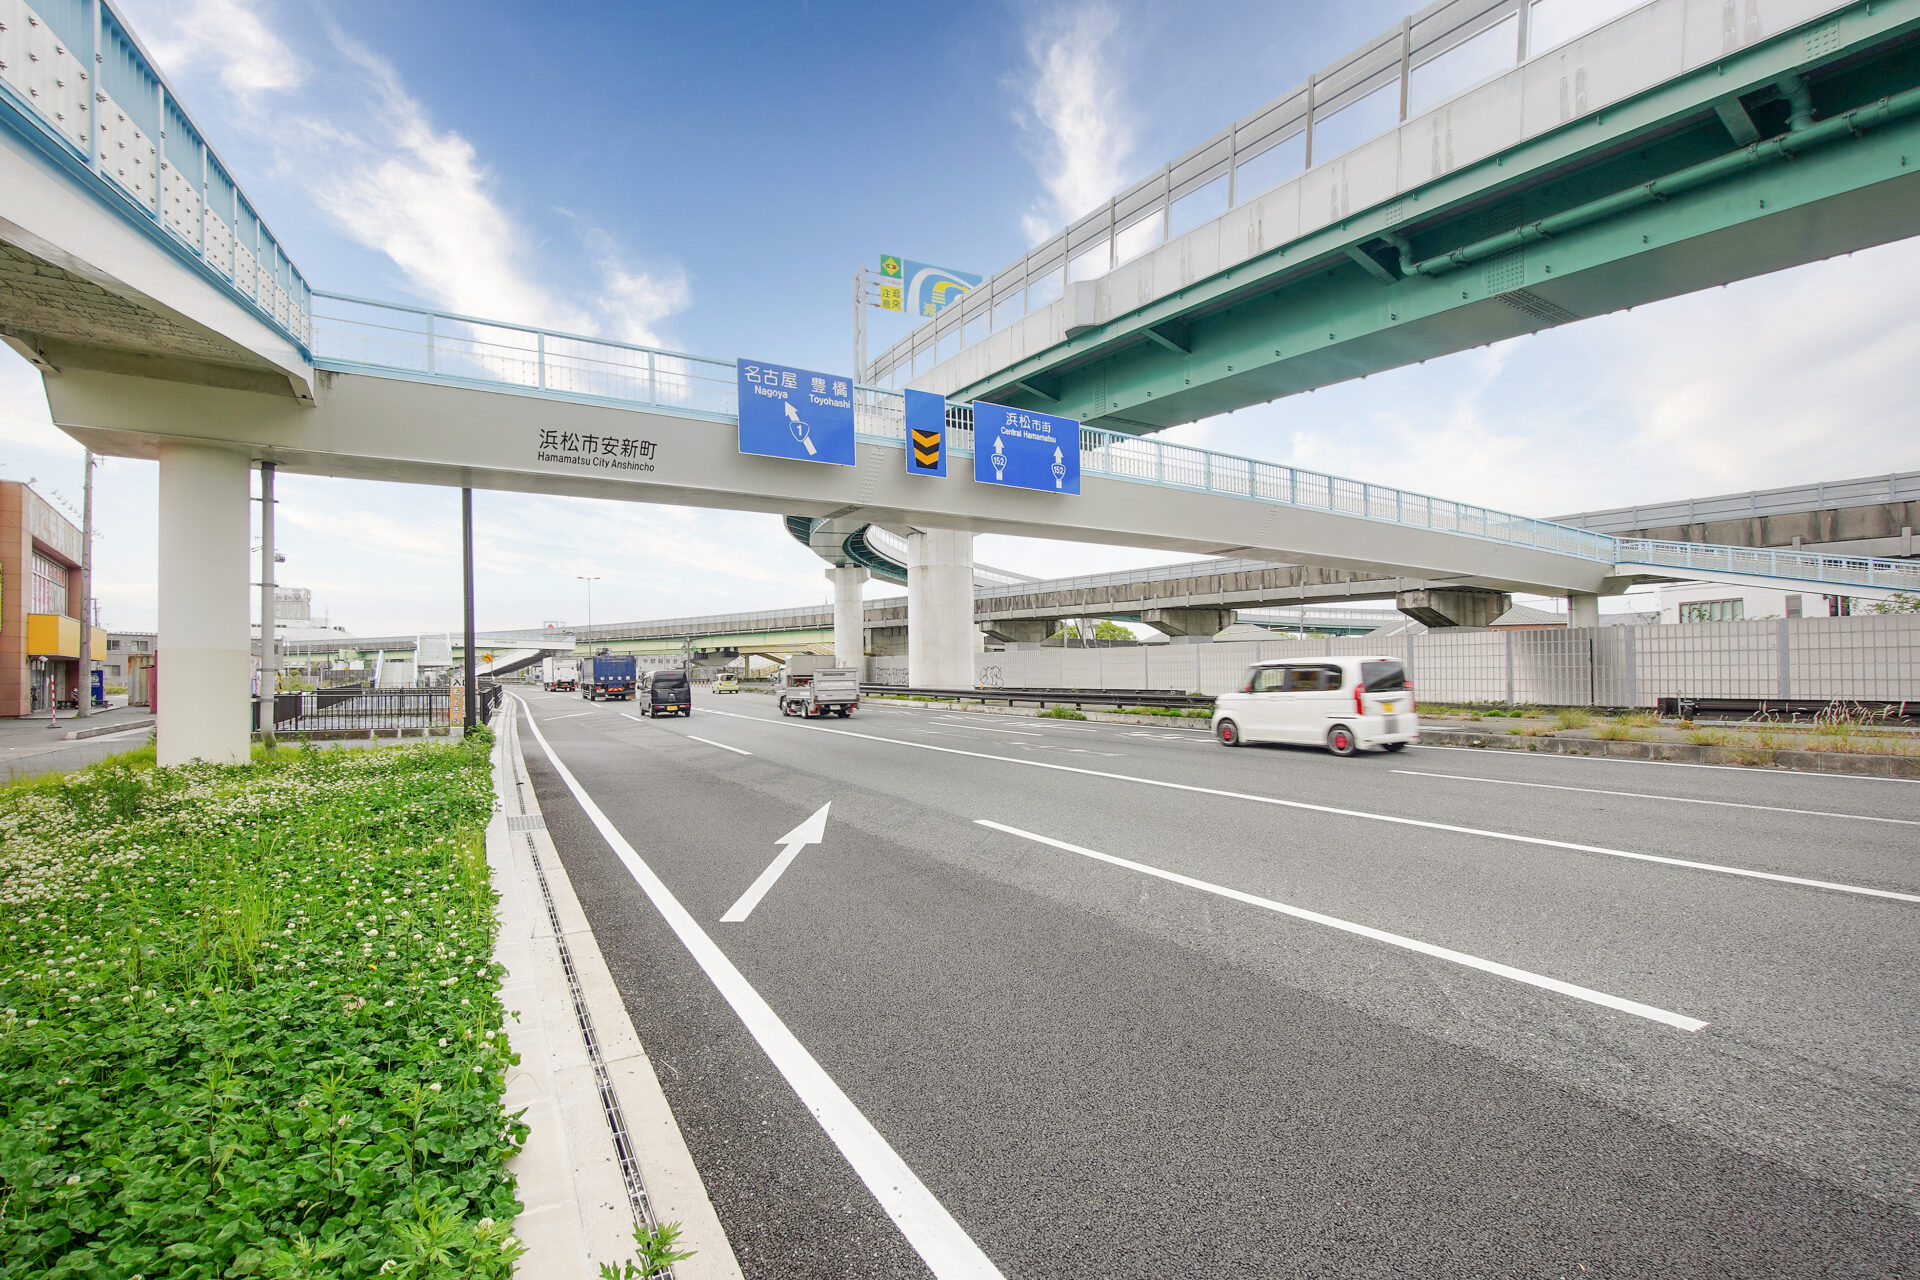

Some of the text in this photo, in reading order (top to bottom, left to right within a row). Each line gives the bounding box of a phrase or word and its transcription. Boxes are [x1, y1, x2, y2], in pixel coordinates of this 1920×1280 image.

[744, 365, 848, 398] 名古屋 豊橋
[754, 384, 851, 409] Nagoya Toyohashi
[796, 424, 803, 437] 1
[1005, 411, 1051, 434] 浜松市街
[539, 428, 658, 461] 浜松市安新町
[1000, 426, 1057, 443] Central Hamamatsu
[537, 450, 655, 473] Hamamatsu City Anshincho
[993, 456, 1004, 466] 152
[1053, 465, 1064, 475] 152
